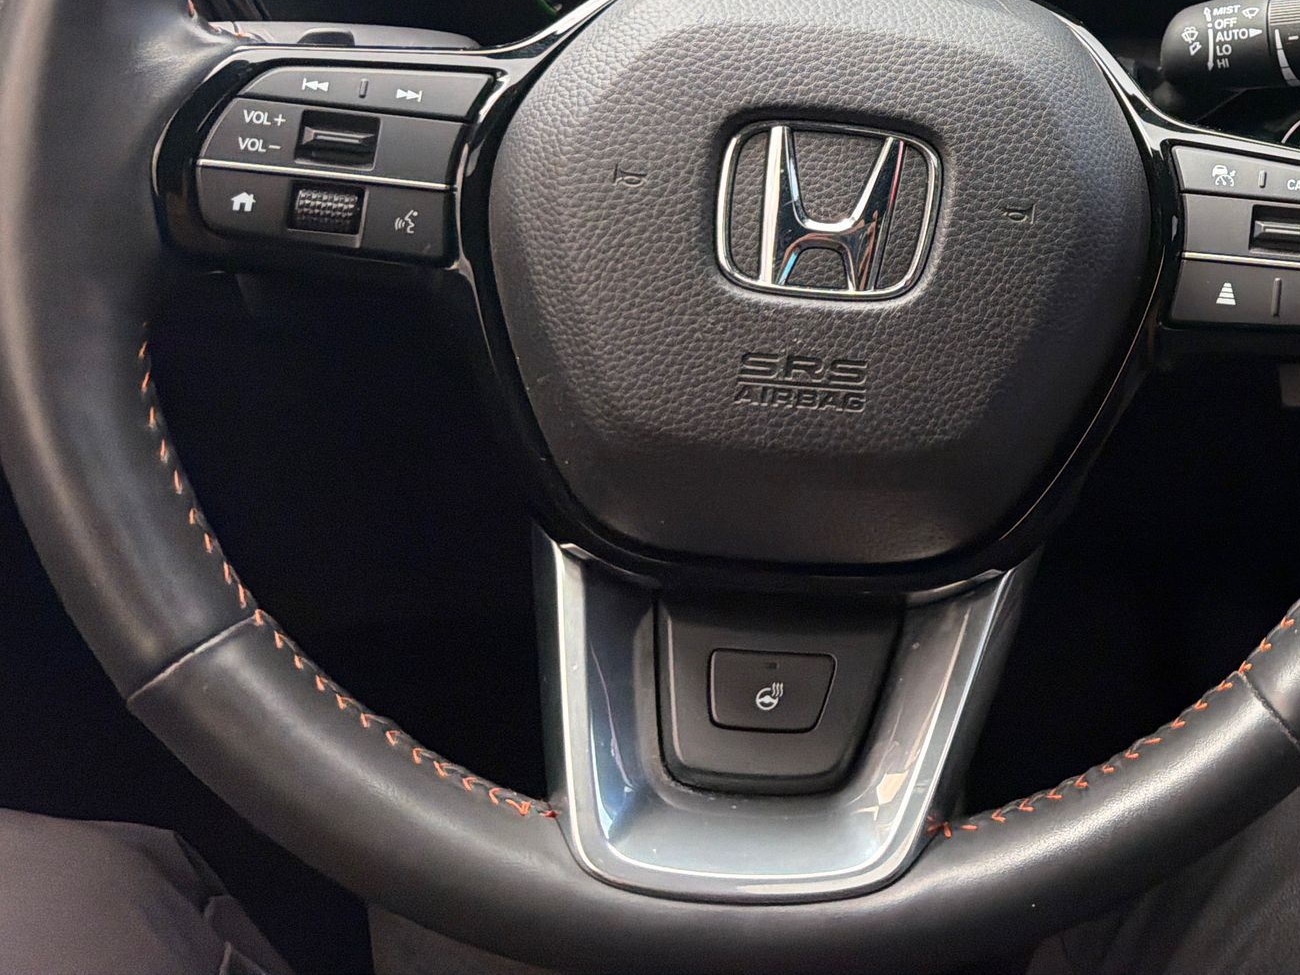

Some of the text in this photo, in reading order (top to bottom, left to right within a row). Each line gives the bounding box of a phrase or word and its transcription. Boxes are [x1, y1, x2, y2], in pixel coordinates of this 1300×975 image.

[1213, 5, 1241, 16] MIST
[1214, 17, 1237, 29] OFF
[1216, 29, 1248, 42] AUTO
[1217, 44, 1232, 56] LO
[1217, 58, 1230, 68] HI
[738, 352, 868, 385] SRS
[734, 386, 868, 413] AIRBAG
